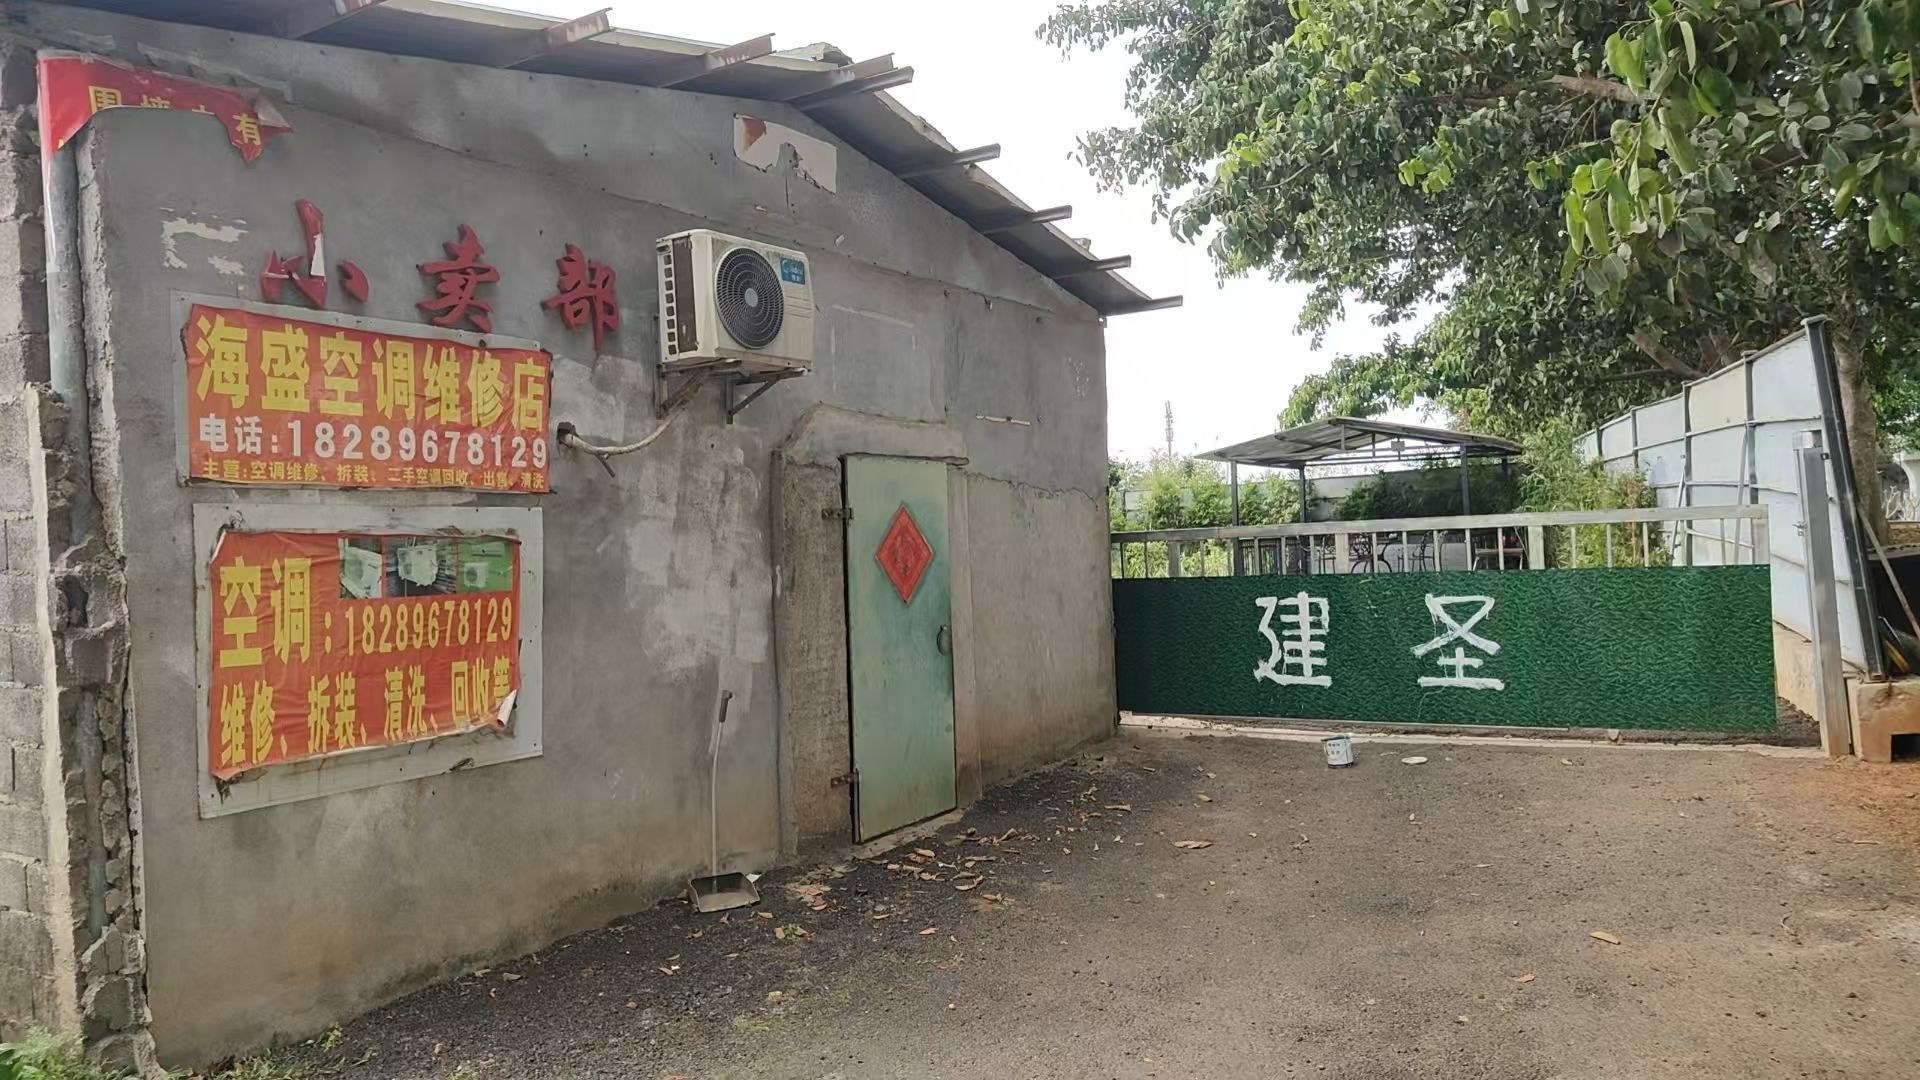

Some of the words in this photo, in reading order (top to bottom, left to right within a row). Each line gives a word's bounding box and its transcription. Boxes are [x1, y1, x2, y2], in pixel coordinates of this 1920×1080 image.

[261, 198, 620, 350] 小卖部
[196, 314, 547, 432] 海盛空调维修店
